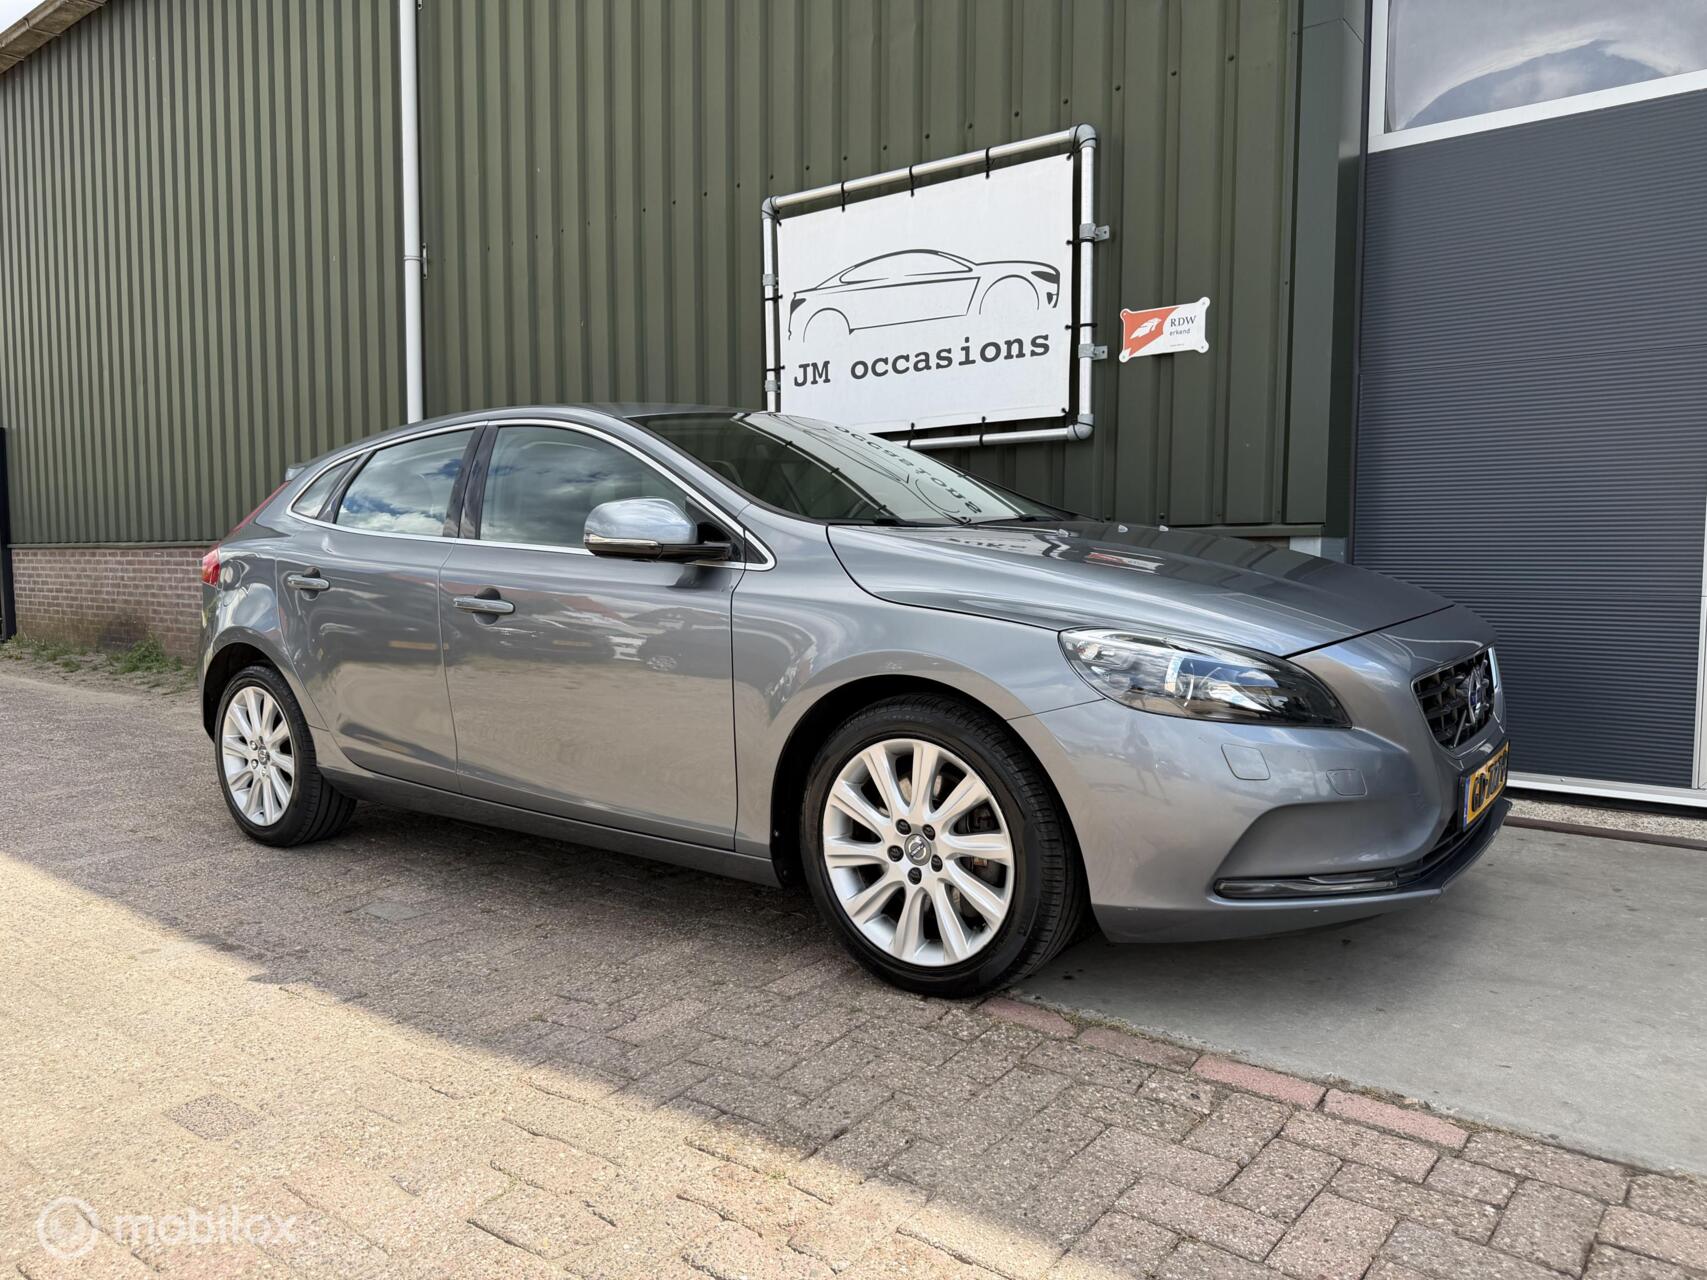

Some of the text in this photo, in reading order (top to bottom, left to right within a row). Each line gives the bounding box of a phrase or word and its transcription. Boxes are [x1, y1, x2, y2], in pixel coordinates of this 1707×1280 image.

[1170, 315, 1196, 327] RDW
[794, 334, 1050, 387] JM occasions
